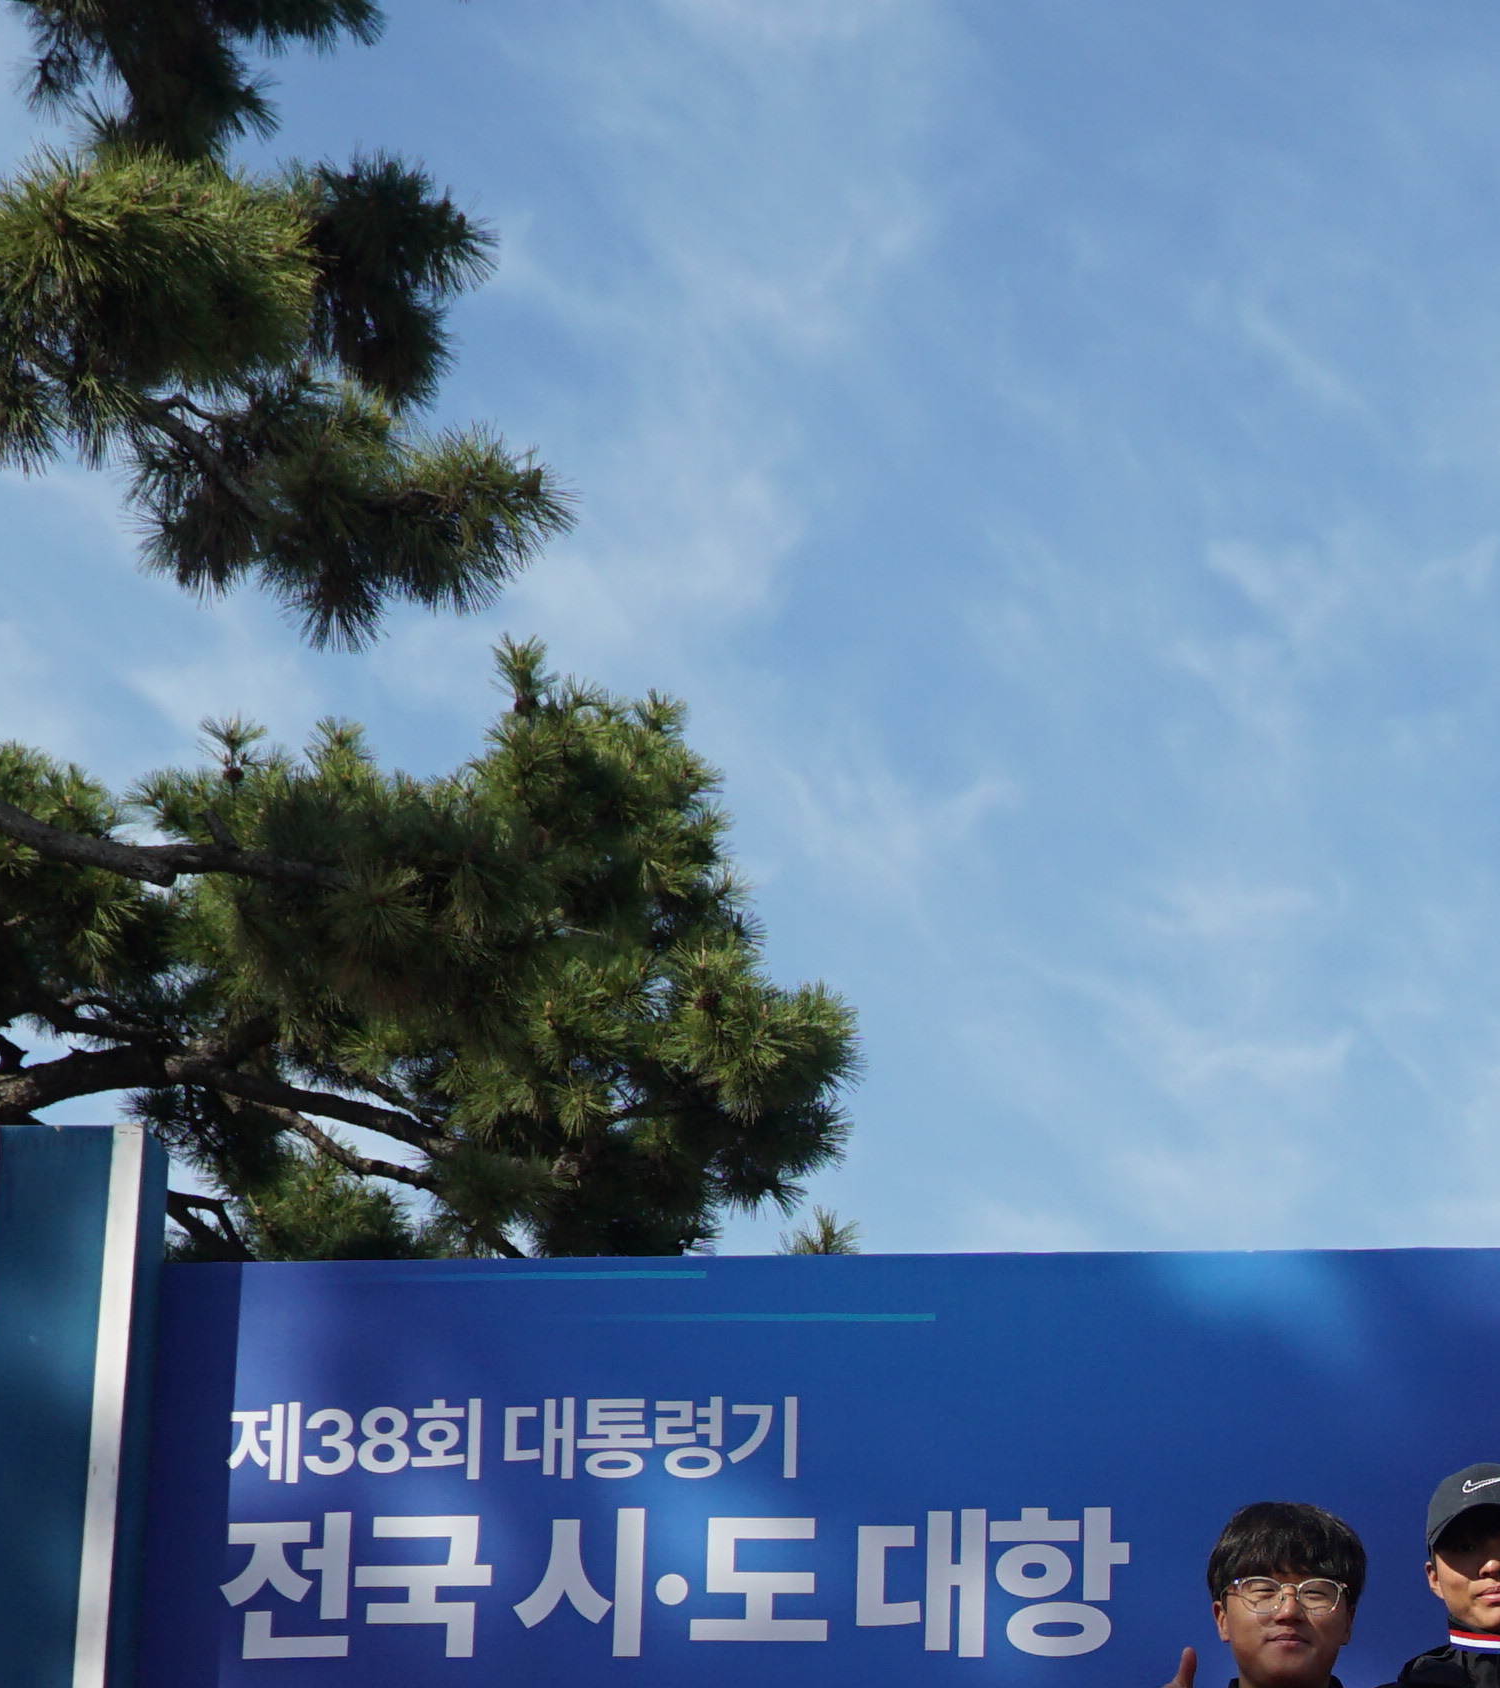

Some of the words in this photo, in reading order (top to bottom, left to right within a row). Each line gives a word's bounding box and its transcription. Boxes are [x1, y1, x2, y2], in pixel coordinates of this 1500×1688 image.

[226, 1399, 481, 1483] 제38회
[504, 1397, 797, 1479] 대통령기
[221, 1512, 492, 1659] 전국
[513, 1508, 827, 1656] 시·도
[856, 1507, 1129, 1657] 대항
